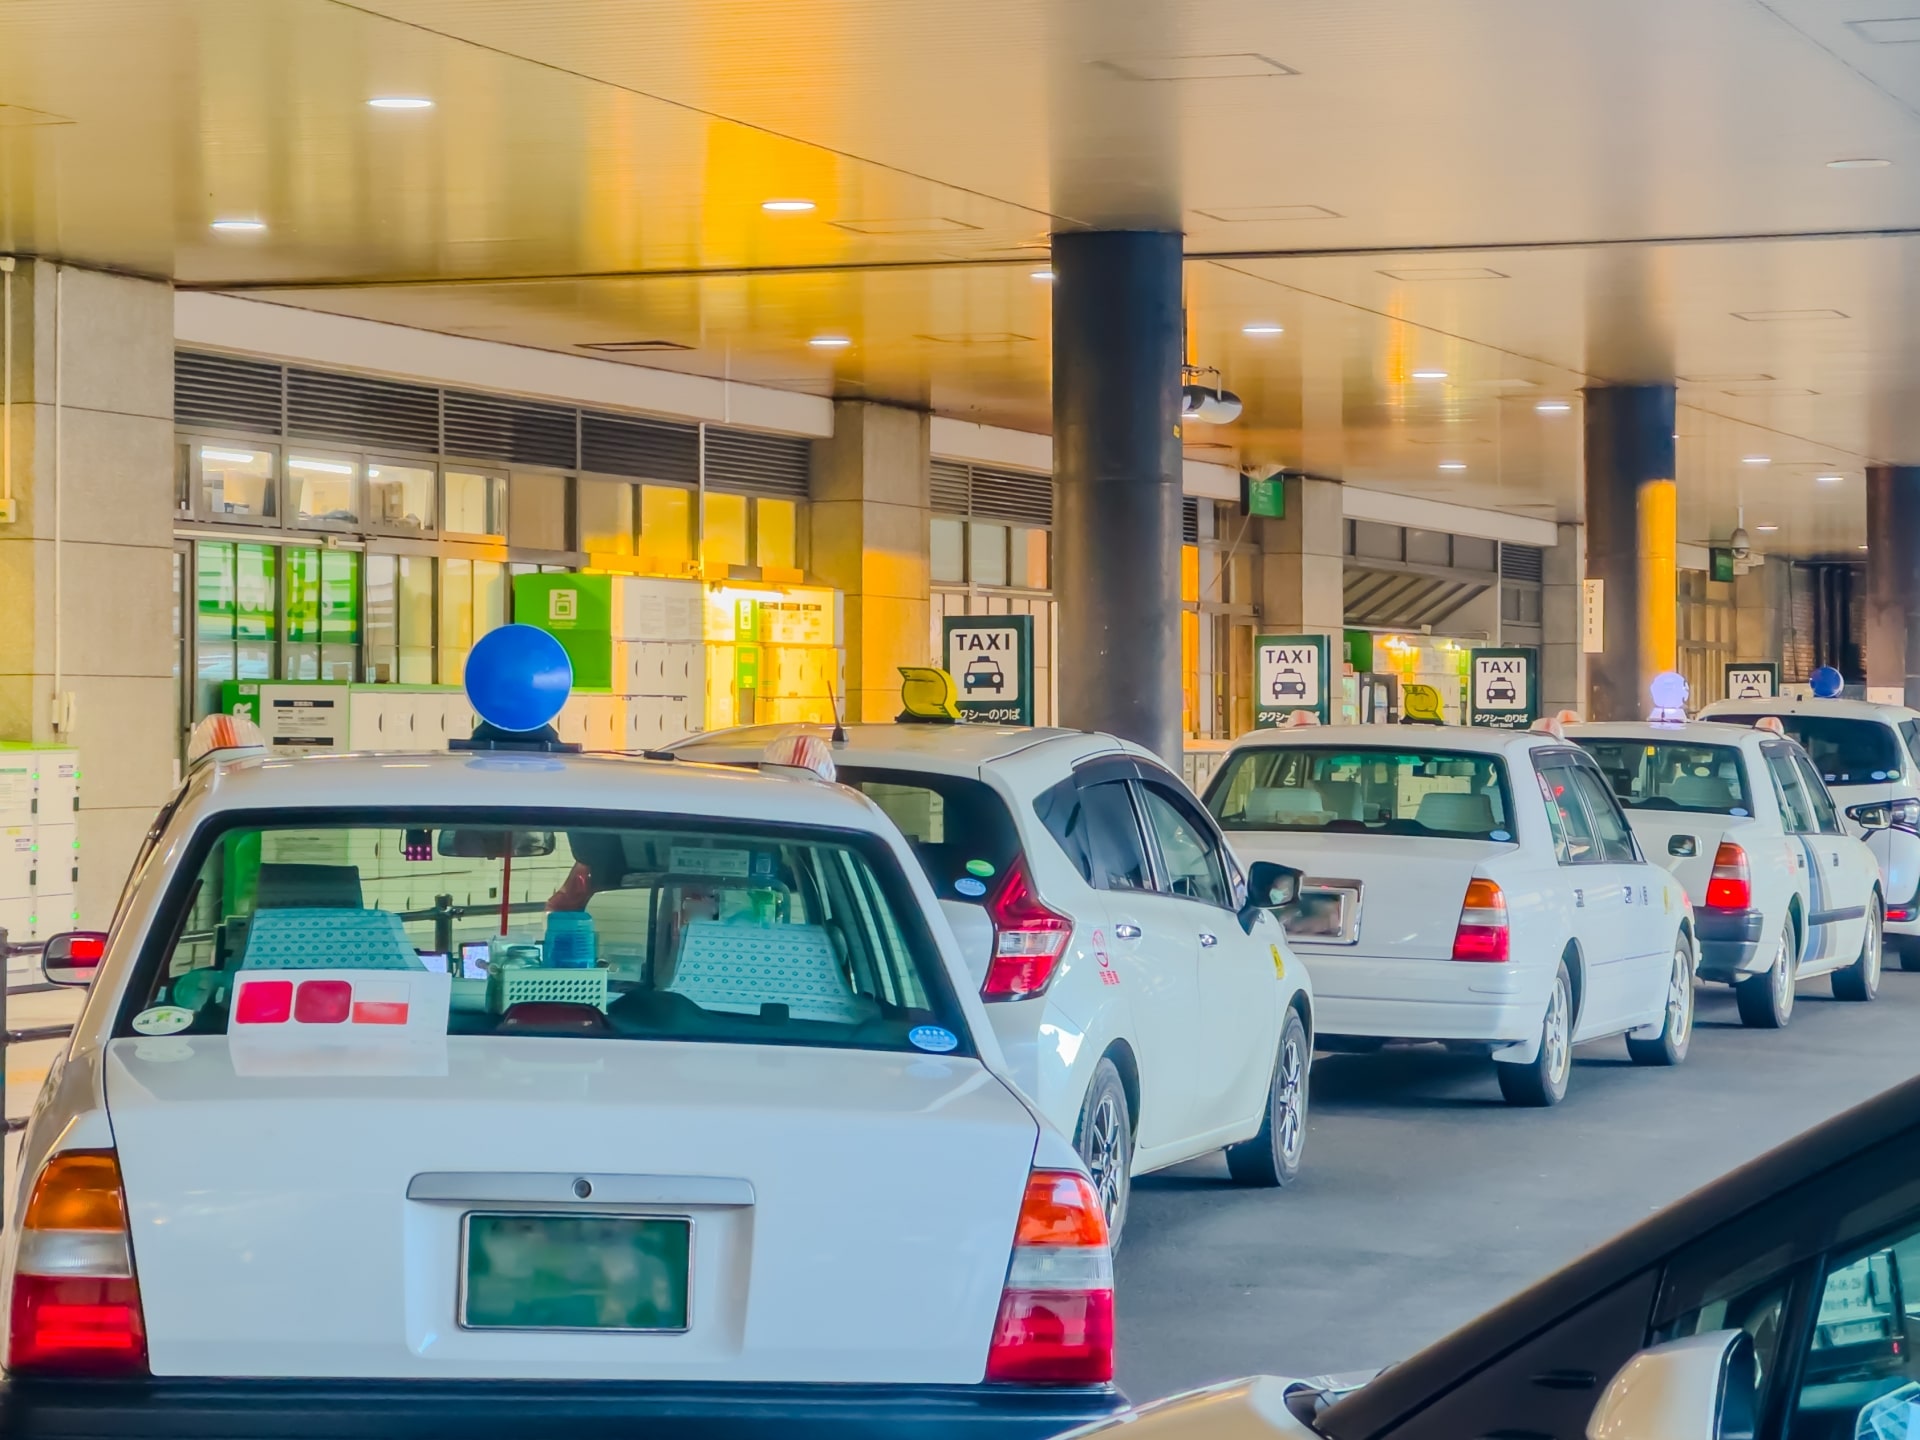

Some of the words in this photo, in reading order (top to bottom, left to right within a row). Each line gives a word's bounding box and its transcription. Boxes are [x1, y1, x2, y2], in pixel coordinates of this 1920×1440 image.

[955, 633, 1010, 651] TAXI
[1265, 649, 1312, 664] TAXI
[1480, 661, 1521, 674] TAXI
[1733, 673, 1767, 684] TAXI
[960, 708, 1021, 720] クシーのりば
[1474, 713, 1529, 723] タクシーのりば
